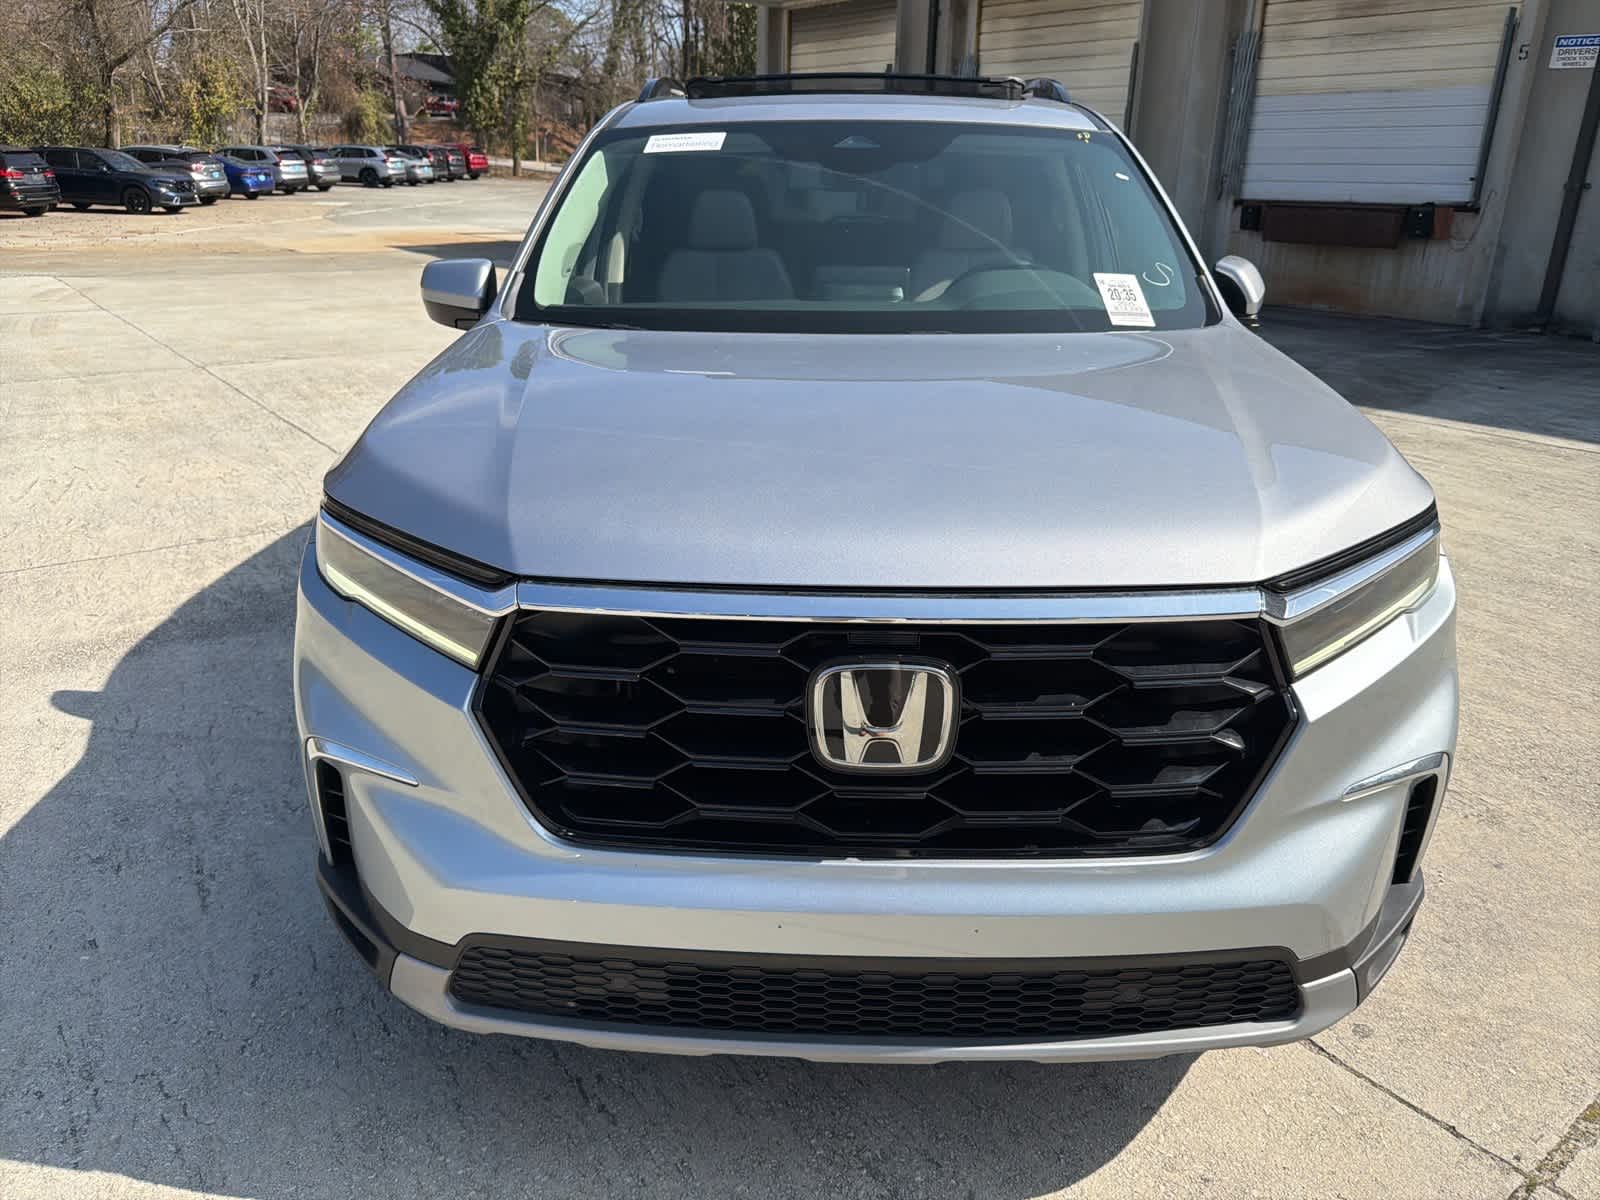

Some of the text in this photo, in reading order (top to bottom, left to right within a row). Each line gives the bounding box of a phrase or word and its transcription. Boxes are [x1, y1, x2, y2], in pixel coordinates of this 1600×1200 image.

[1559, 37, 1600, 46] NOTICE
[1518, 44, 1530, 61] 5
[1558, 48, 1598, 56] DRIVERS
